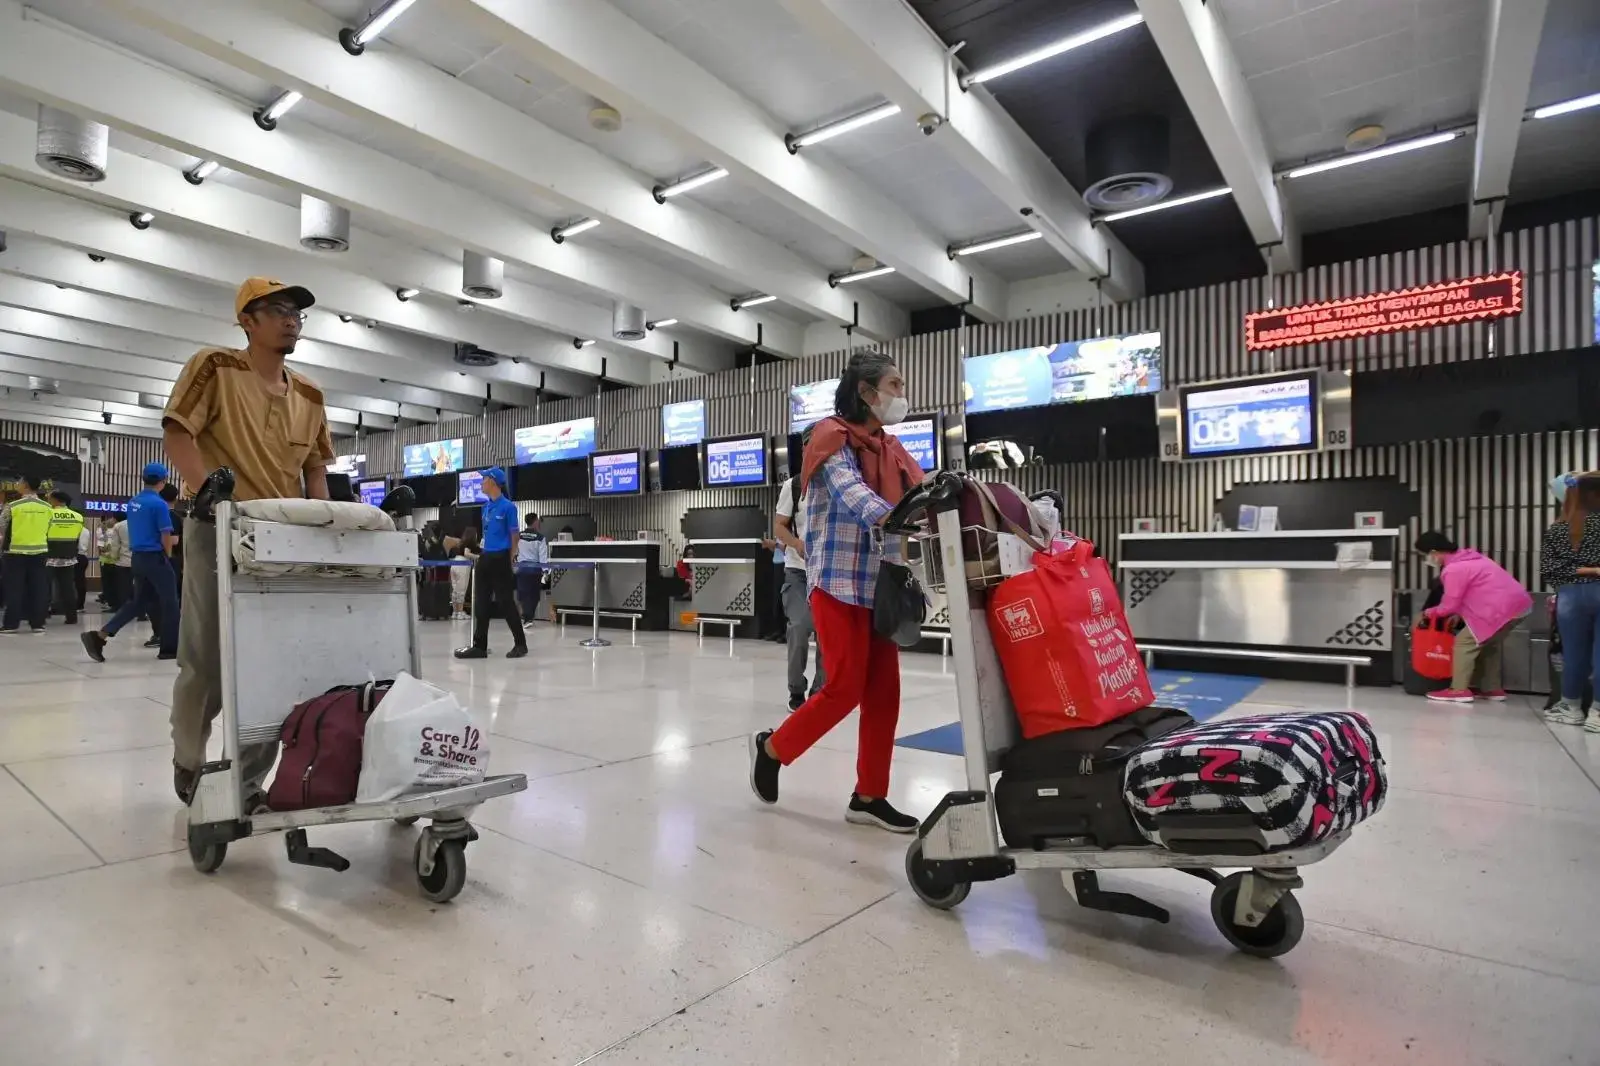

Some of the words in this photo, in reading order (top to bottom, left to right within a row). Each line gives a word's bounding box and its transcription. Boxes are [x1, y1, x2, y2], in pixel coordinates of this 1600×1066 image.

[1286, 309, 1332, 326] UNTUK
[1334, 302, 1377, 318] TIDAK
[1379, 287, 1470, 312] MENYIMPAN
[1258, 324, 1313, 342] BARANG
[1313, 313, 1386, 334] BERHARGA
[1389, 305, 1440, 324] DALAM
[1443, 295, 1503, 315] BAGASI
[1194, 417, 1235, 445] 08
[1327, 430, 1346, 444] 08
[710, 460, 729, 479] 06
[951, 458, 963, 470] 07
[596, 472, 612, 488] 05
[779, 472, 789, 482] 06
[85, 500, 119, 511] BLUE
[1010, 625, 1038, 639] INDO
[1094, 643, 1128, 668] Kantong
[421, 726, 460, 744] Care
[461, 725, 480, 751] 12
[420, 741, 434, 756] &
[438, 743, 477, 766] Share
